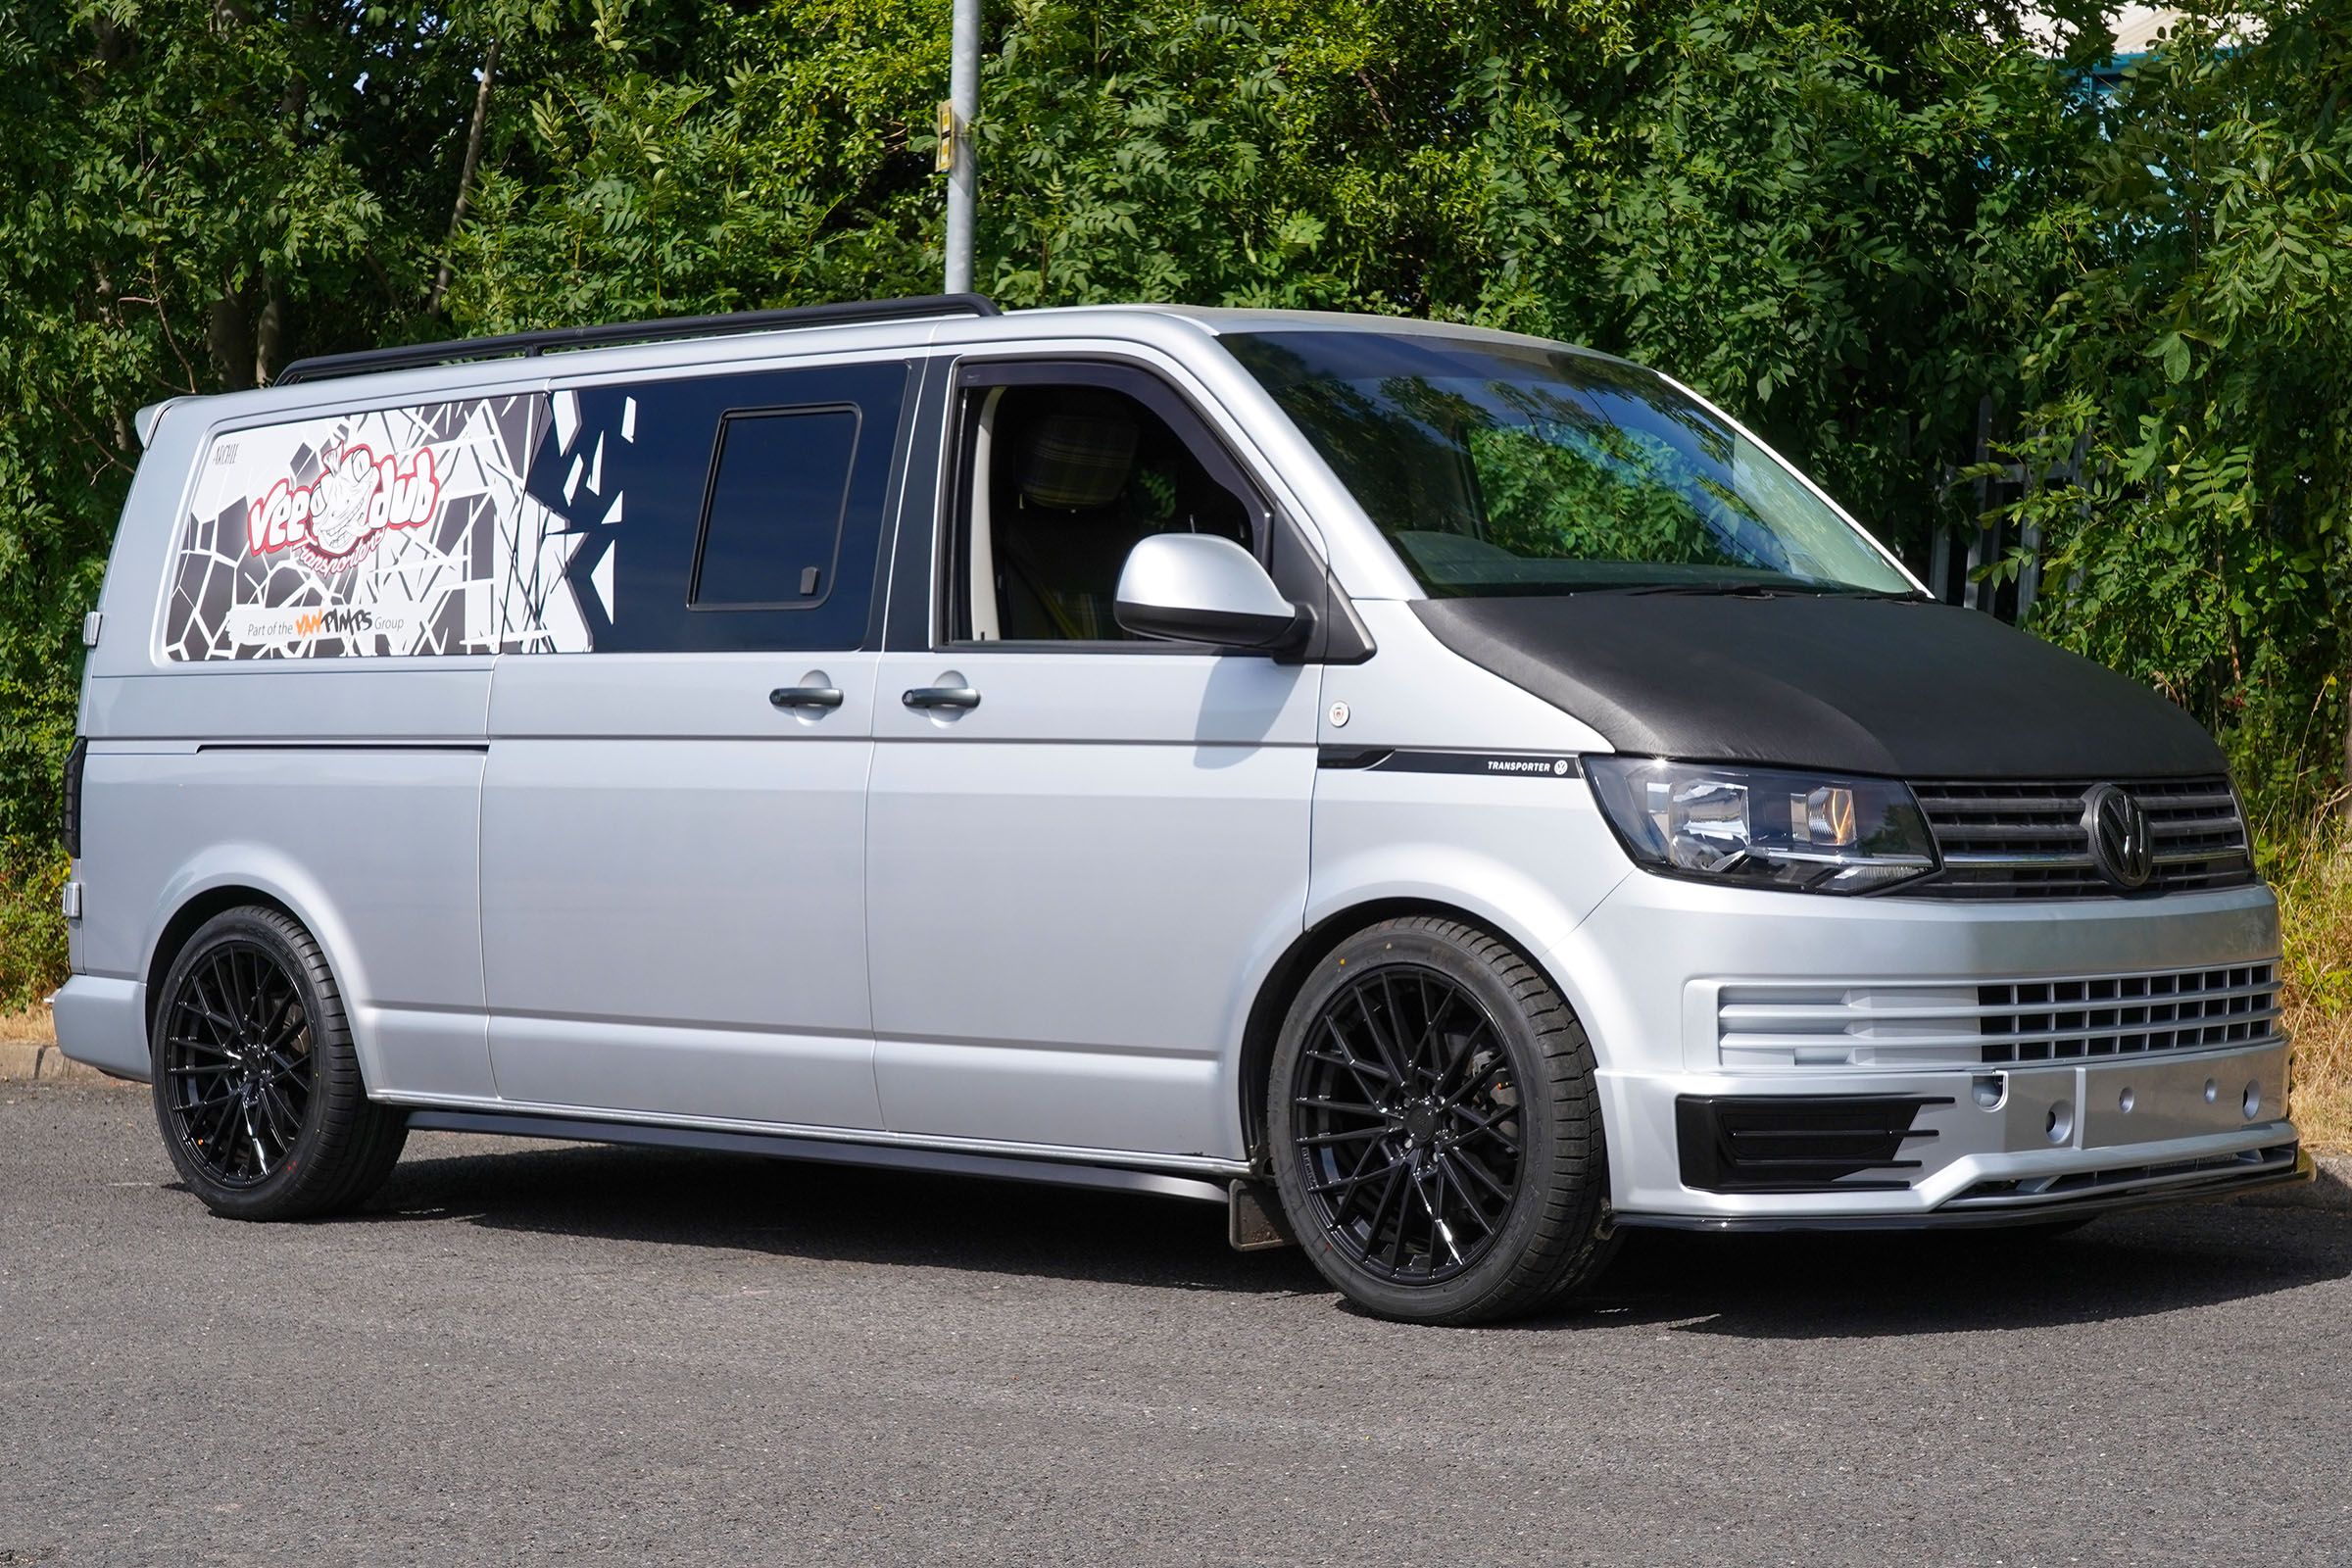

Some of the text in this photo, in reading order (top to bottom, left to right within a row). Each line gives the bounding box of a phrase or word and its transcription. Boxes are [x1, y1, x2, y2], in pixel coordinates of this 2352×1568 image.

[247, 623, 265, 636] Part
[267, 623, 279, 636] of
[280, 621, 293, 635] the
[374, 615, 404, 631] Group
[1488, 760, 1550, 772] TRANSPORTER
